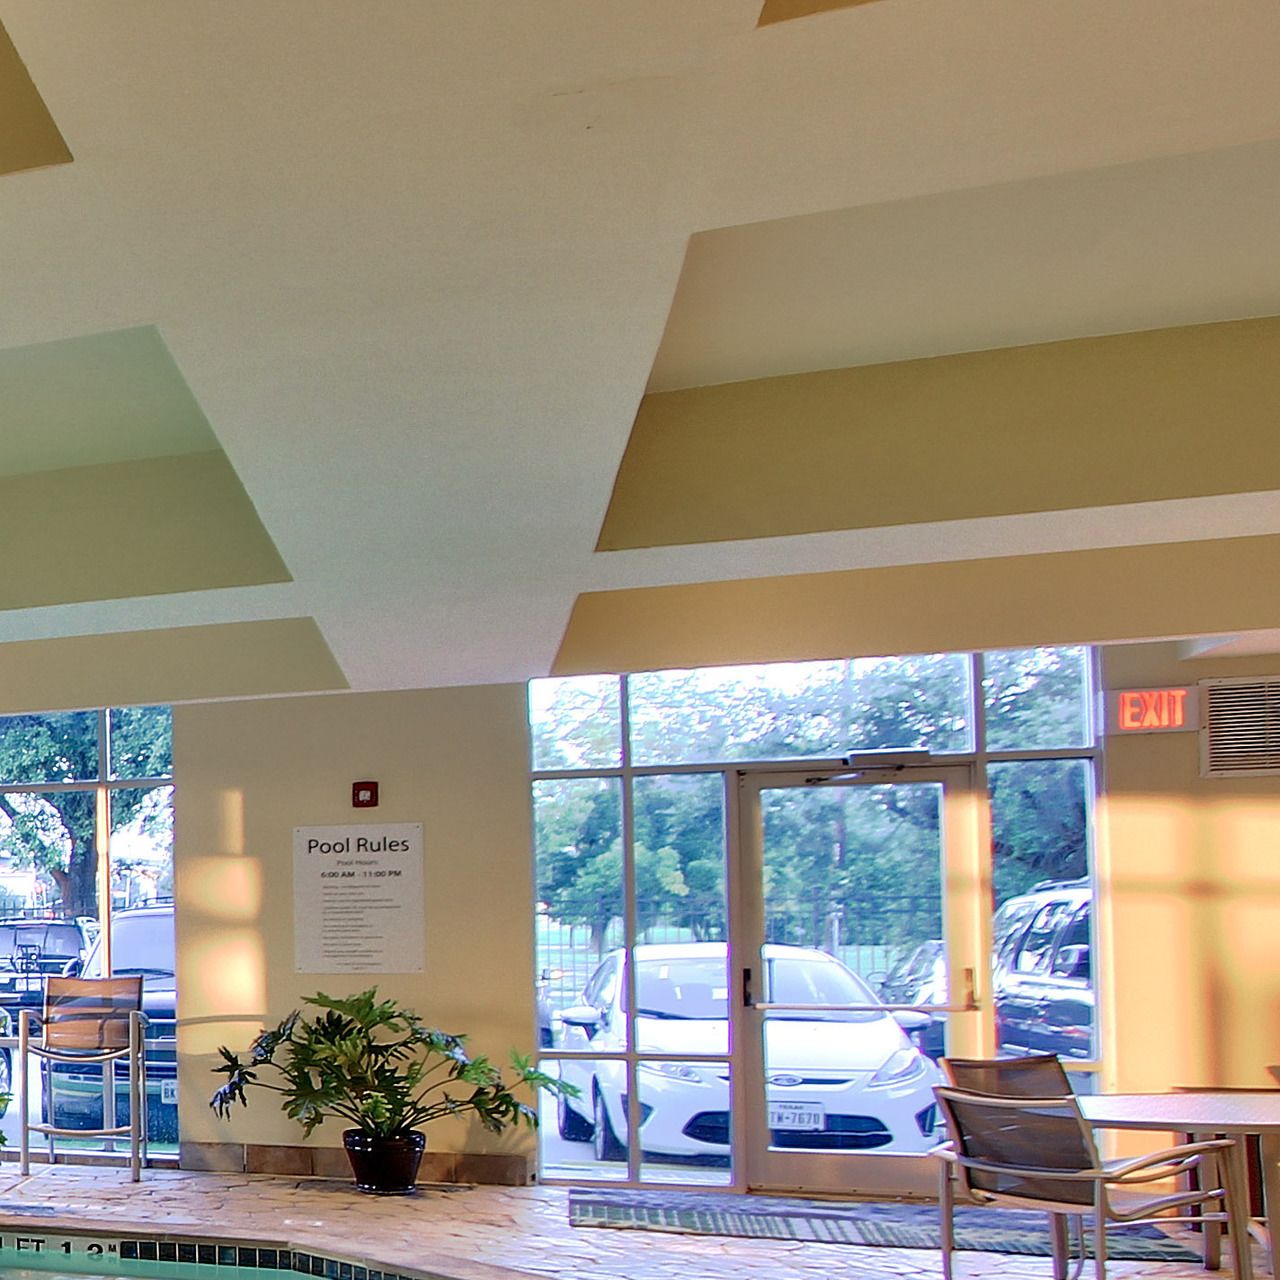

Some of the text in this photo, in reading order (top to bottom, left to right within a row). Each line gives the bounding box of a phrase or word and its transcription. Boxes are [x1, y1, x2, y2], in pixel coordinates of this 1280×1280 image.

[1119, 690, 1187, 730] EXIT
[308, 836, 409, 854] Pool Rules
[17, 1238, 45, 1252] FT
[61, 1241, 71, 1254] 1
